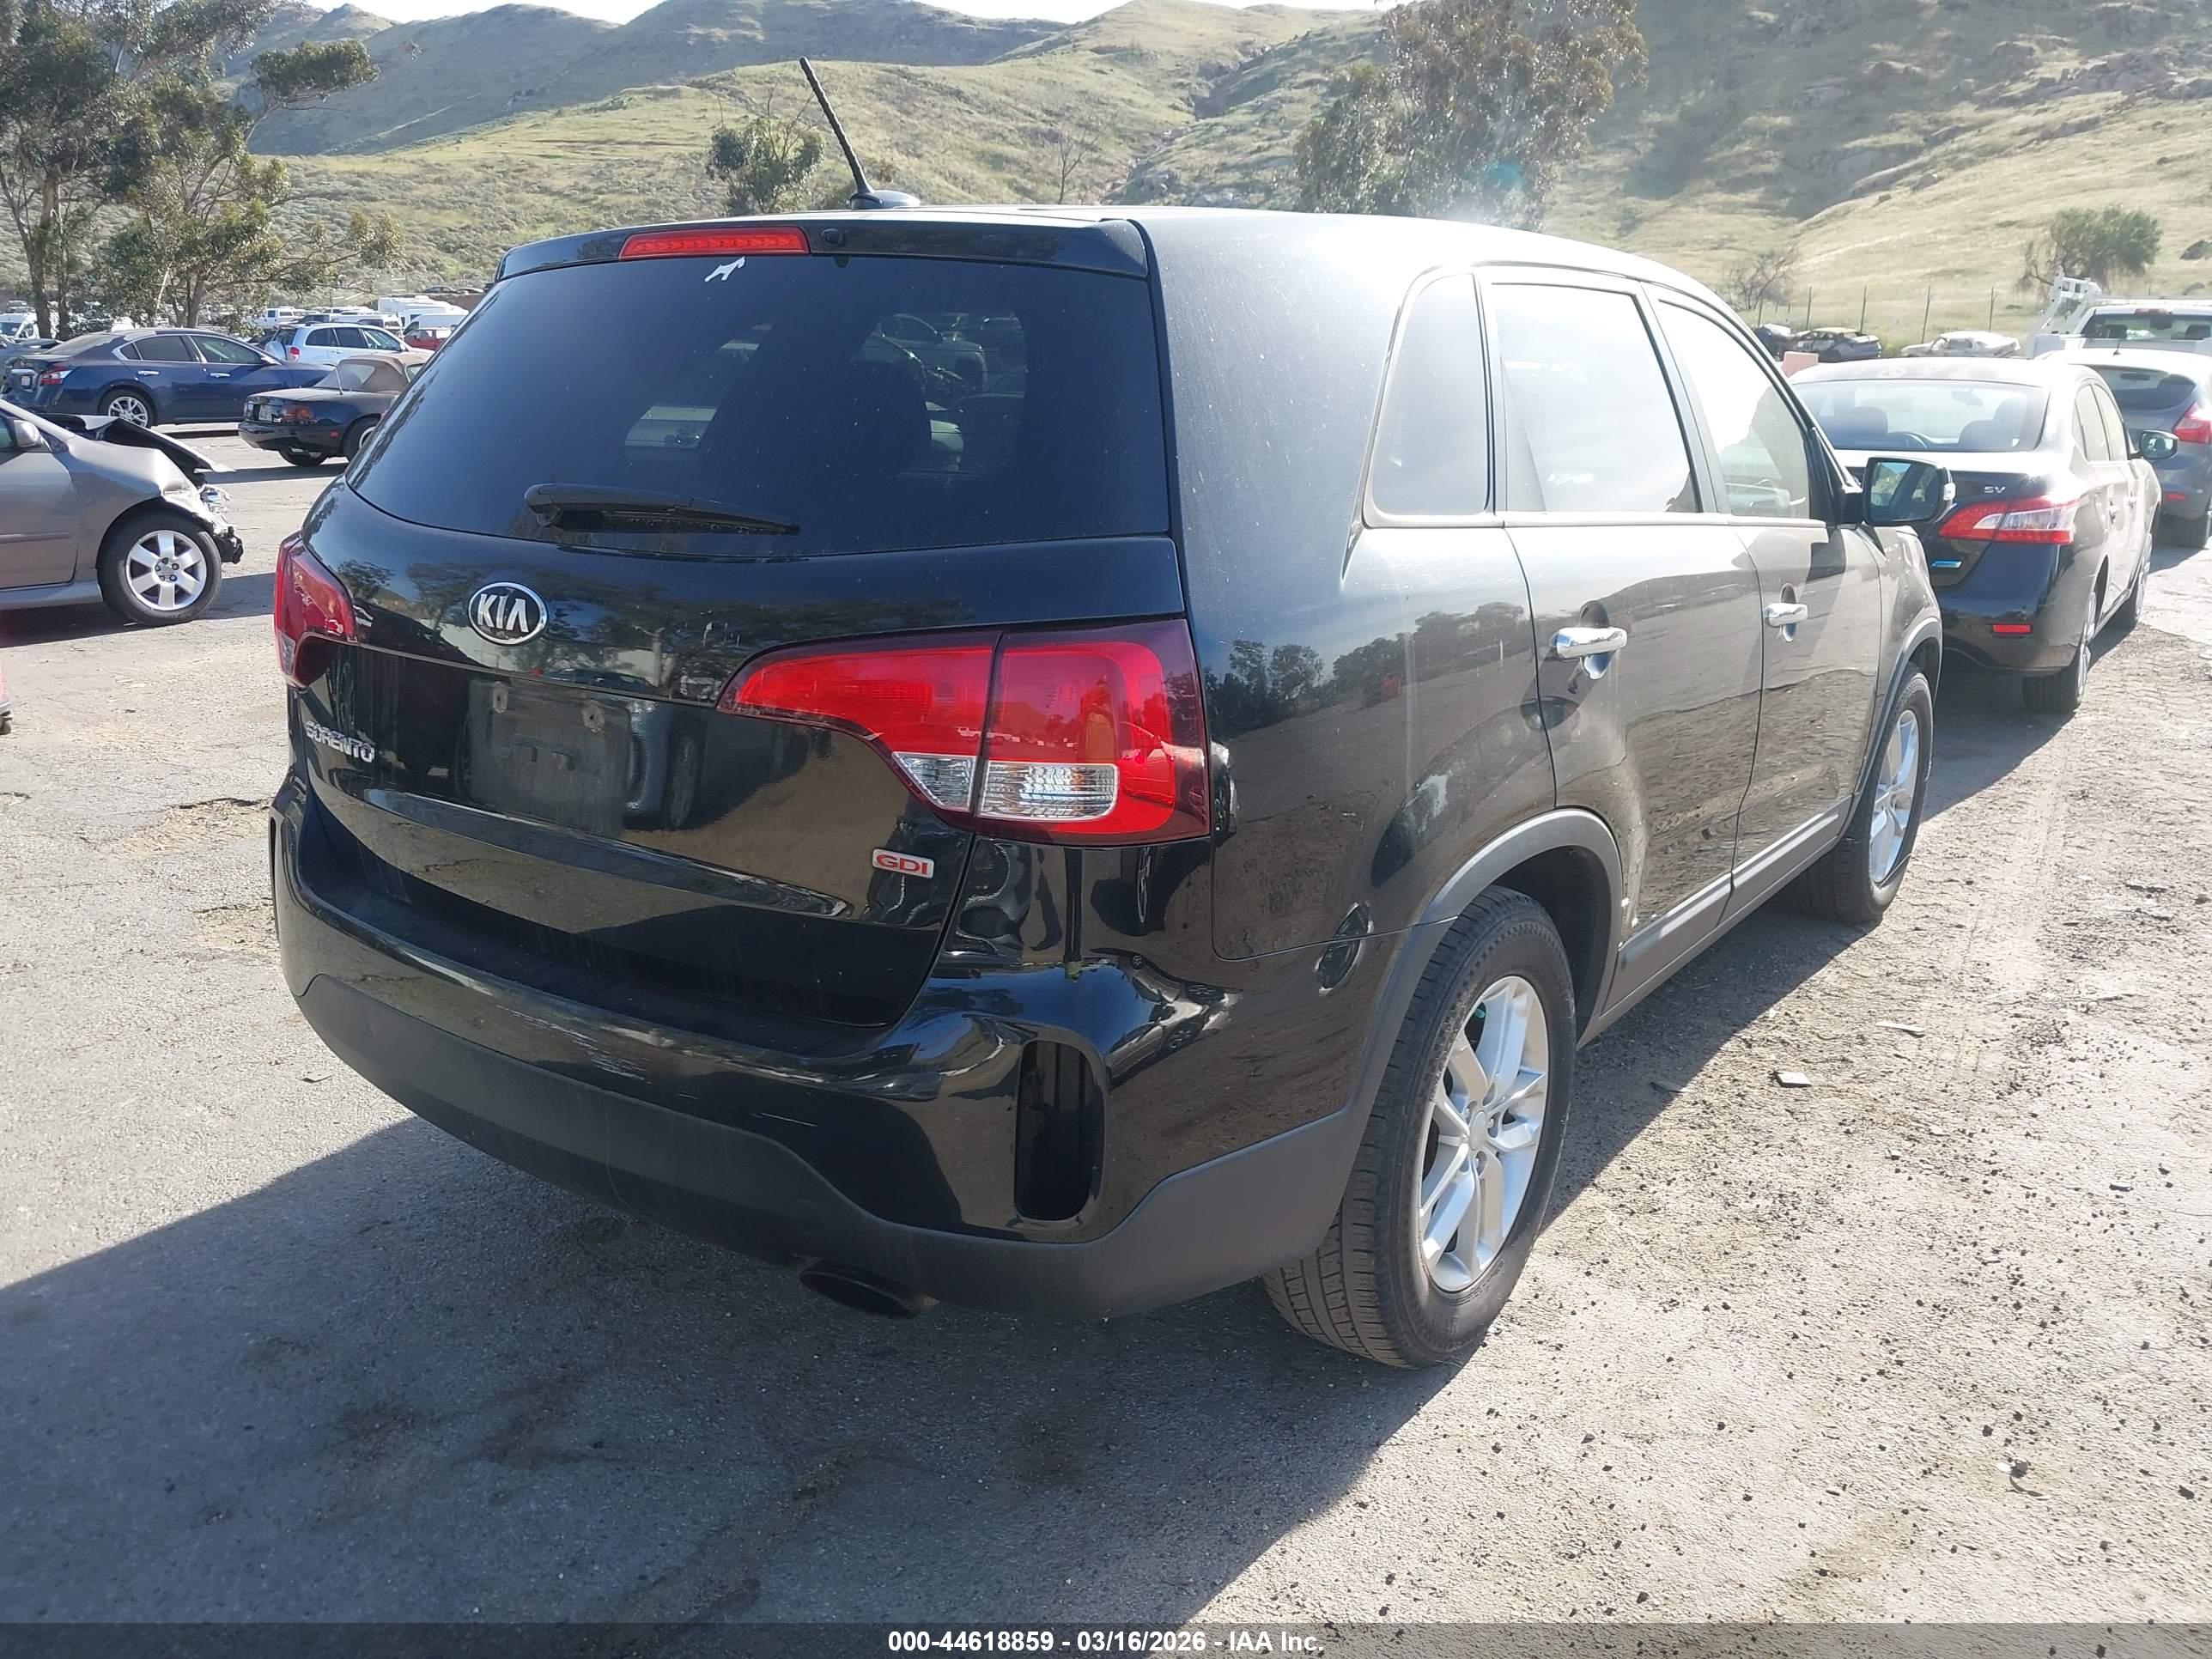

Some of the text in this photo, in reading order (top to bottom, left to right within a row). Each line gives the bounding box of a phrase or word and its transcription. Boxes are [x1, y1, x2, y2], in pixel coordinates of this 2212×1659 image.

[477, 593, 530, 633] KIA
[305, 720, 375, 763] SORENTO
[876, 854, 928, 875] GDI
